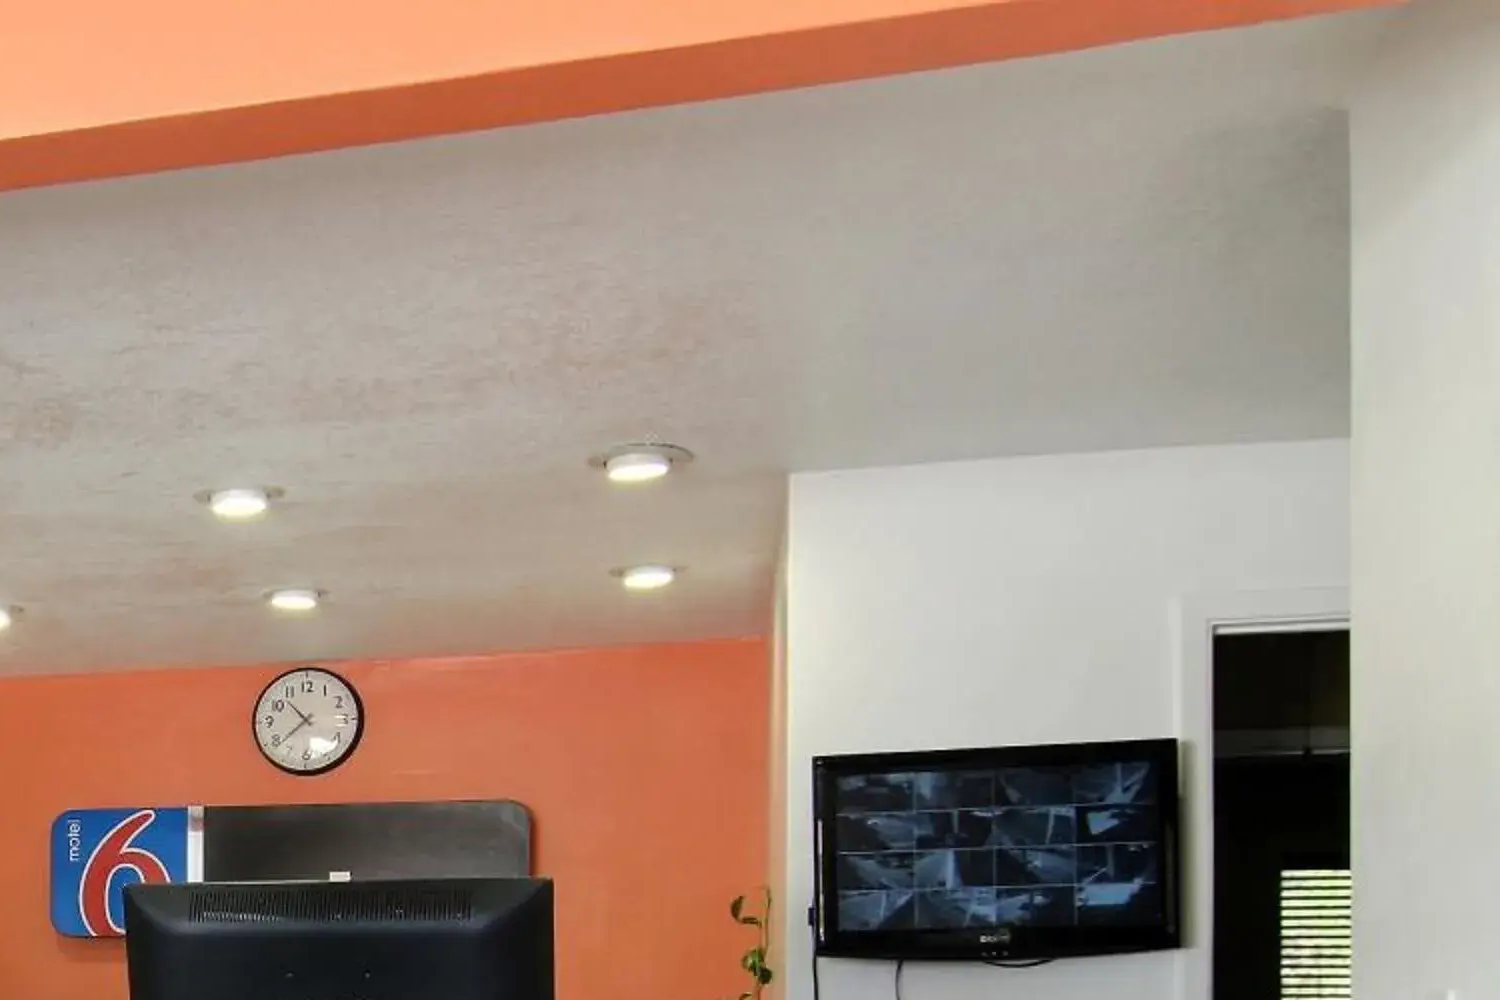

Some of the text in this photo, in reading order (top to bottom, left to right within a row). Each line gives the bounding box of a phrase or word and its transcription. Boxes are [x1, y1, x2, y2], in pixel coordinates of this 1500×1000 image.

[285, 685, 295, 698] 11
[301, 681, 314, 693] 12
[323, 684, 328, 697] 1
[271, 699, 285, 712] 10
[333, 695, 343, 709] 2
[264, 715, 275, 729] 9
[301, 748, 312, 761] 6
[67, 819, 81, 862] motel
[78, 809, 172, 937] 6
